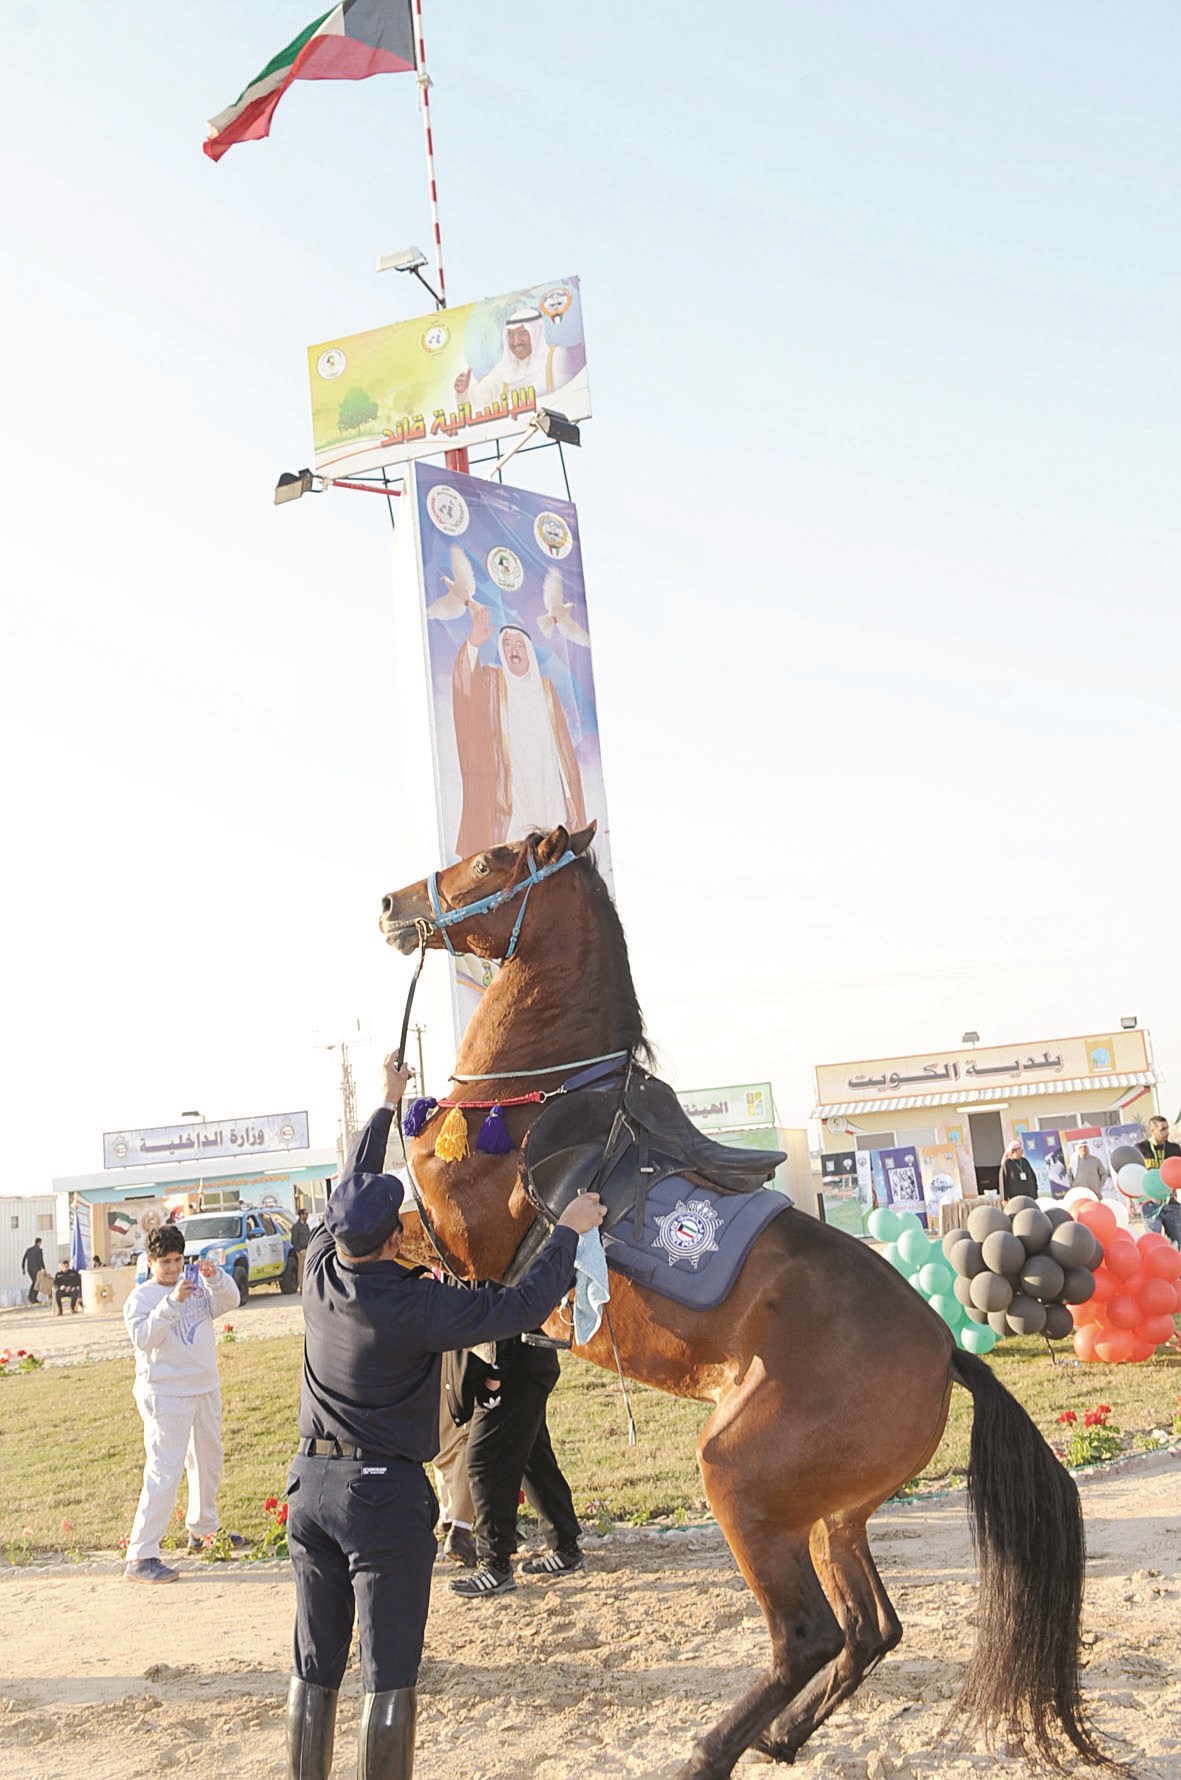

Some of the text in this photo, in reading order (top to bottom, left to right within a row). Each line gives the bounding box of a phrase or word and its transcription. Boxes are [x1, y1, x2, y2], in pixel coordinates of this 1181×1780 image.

[848, 1050, 1064, 1092] بلدية الكويت
[139, 1126, 265, 1155] وزارة الداخلية
